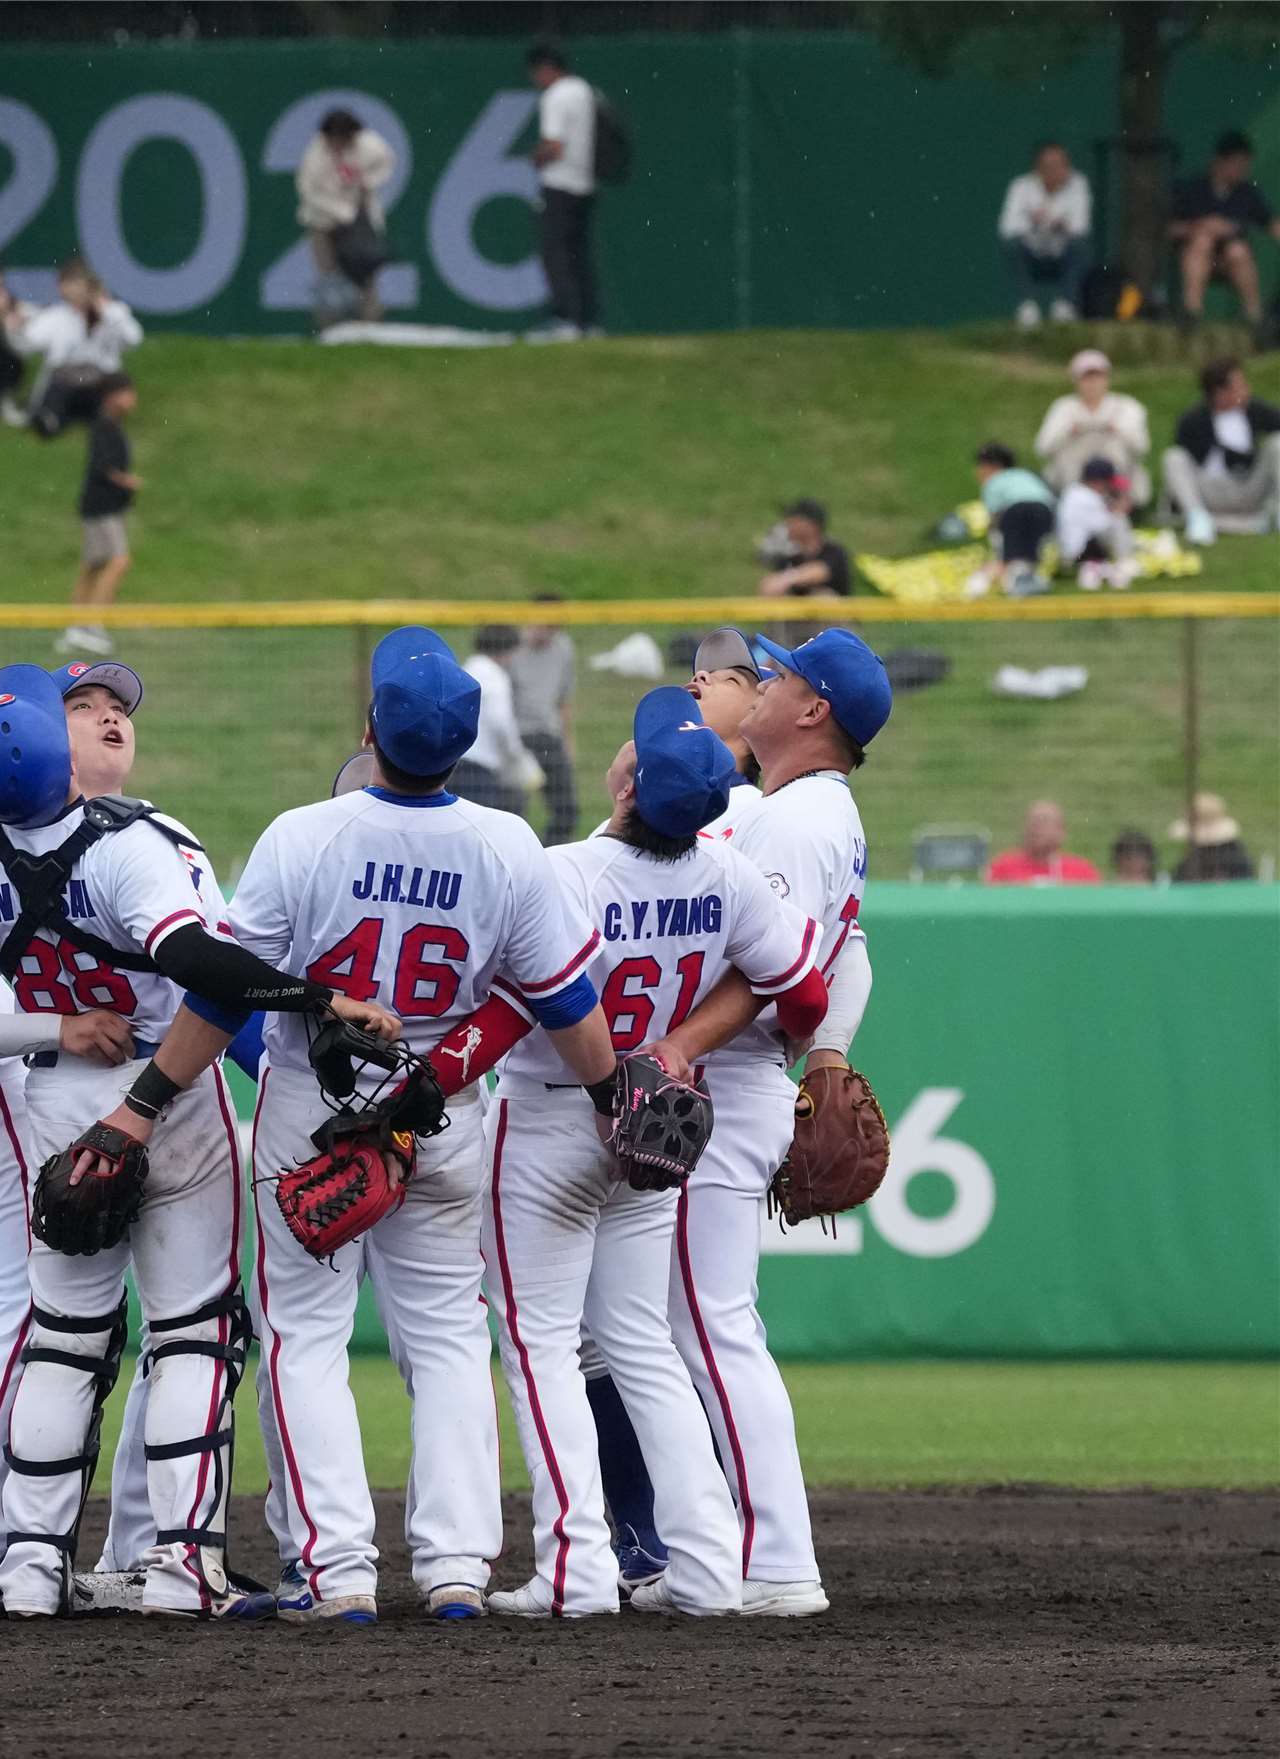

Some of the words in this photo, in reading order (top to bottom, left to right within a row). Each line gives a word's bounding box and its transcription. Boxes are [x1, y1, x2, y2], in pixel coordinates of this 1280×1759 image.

[352, 861, 463, 911] J.H.LIU
[603, 894, 723, 942] C.Y.YANG
[14, 935, 138, 1017] 88
[306, 916, 470, 1018] 46
[600, 950, 706, 1052] 61
